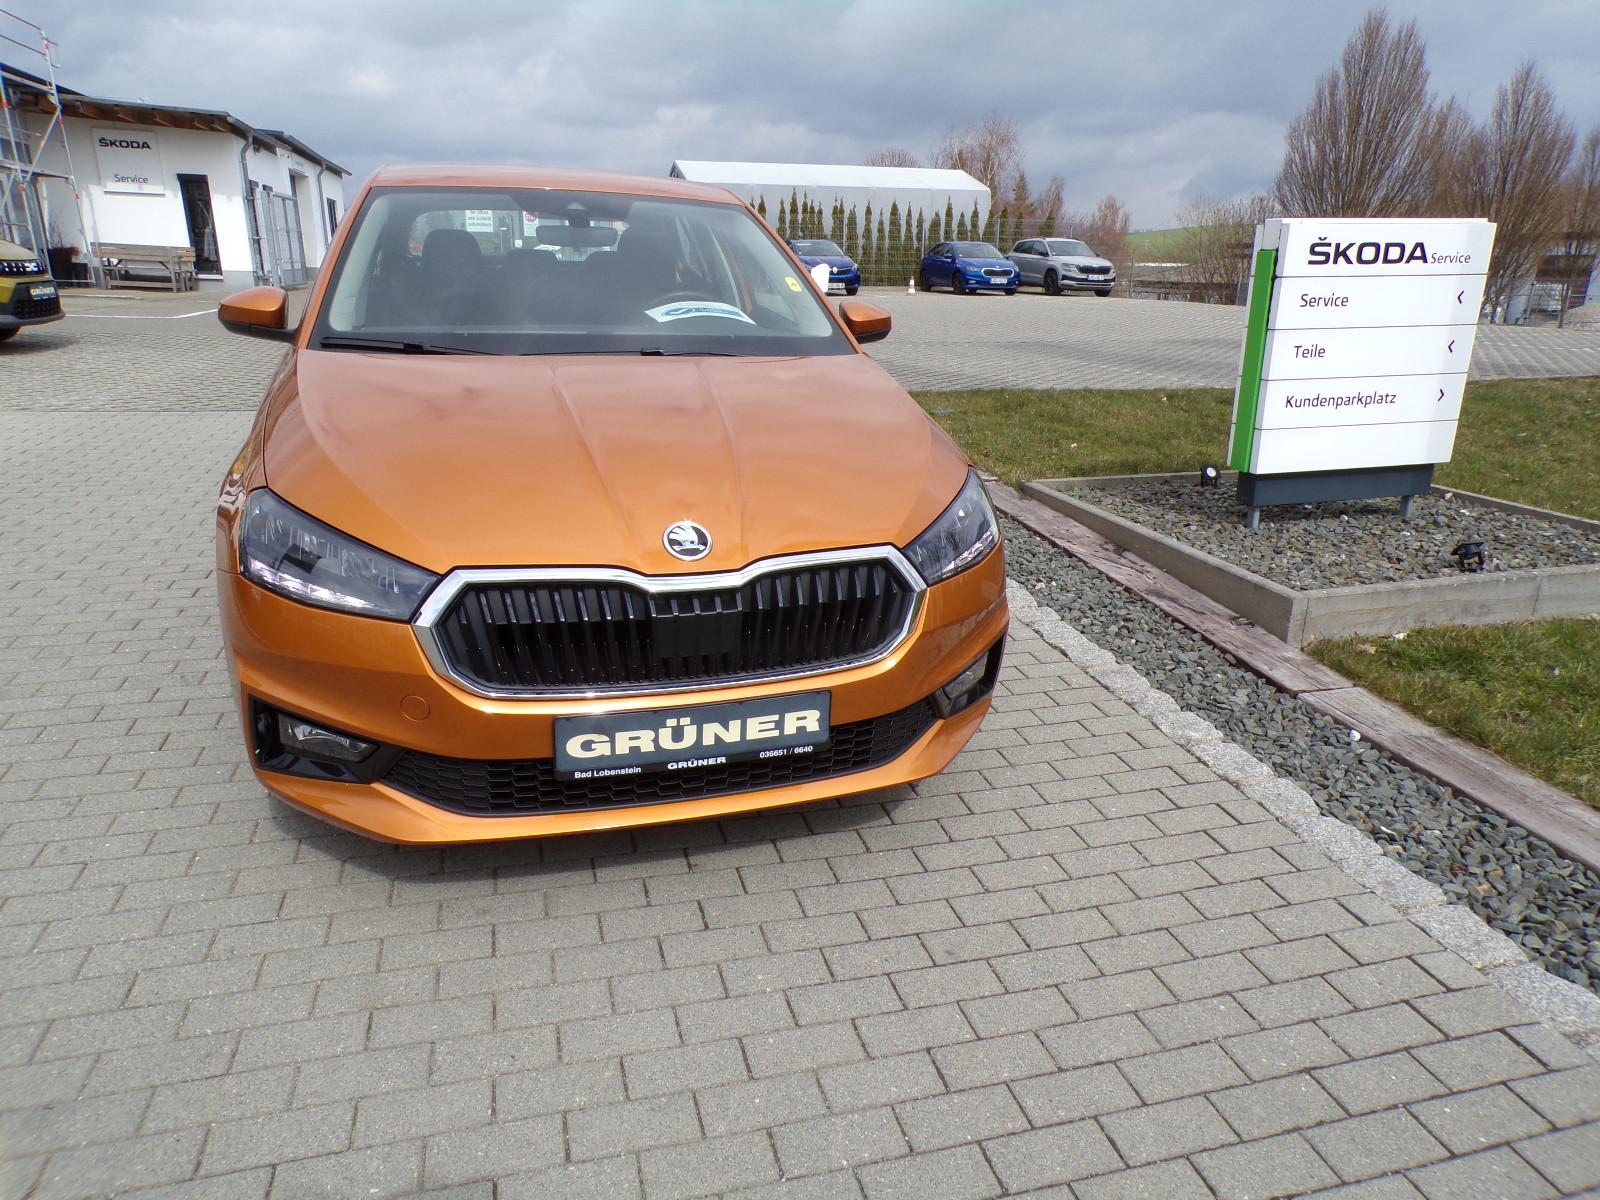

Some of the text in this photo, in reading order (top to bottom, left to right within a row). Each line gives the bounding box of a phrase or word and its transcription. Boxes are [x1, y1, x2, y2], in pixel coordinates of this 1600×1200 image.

[98, 136, 152, 150] ŠKODA
[113, 173, 149, 184] Service
[1307, 236, 1471, 265] ŠKODA Service
[1299, 293, 1349, 308] Service
[1293, 344, 1326, 359] Teile
[1285, 390, 1397, 410] Kundenparkplatz
[565, 709, 821, 759] GRÜNER
[759, 748, 787, 759] 036651
[794, 745, 813, 754] 6640
[667, 756, 727, 770] GRÜNER
[574, 766, 642, 779] Bad Lobenstein
